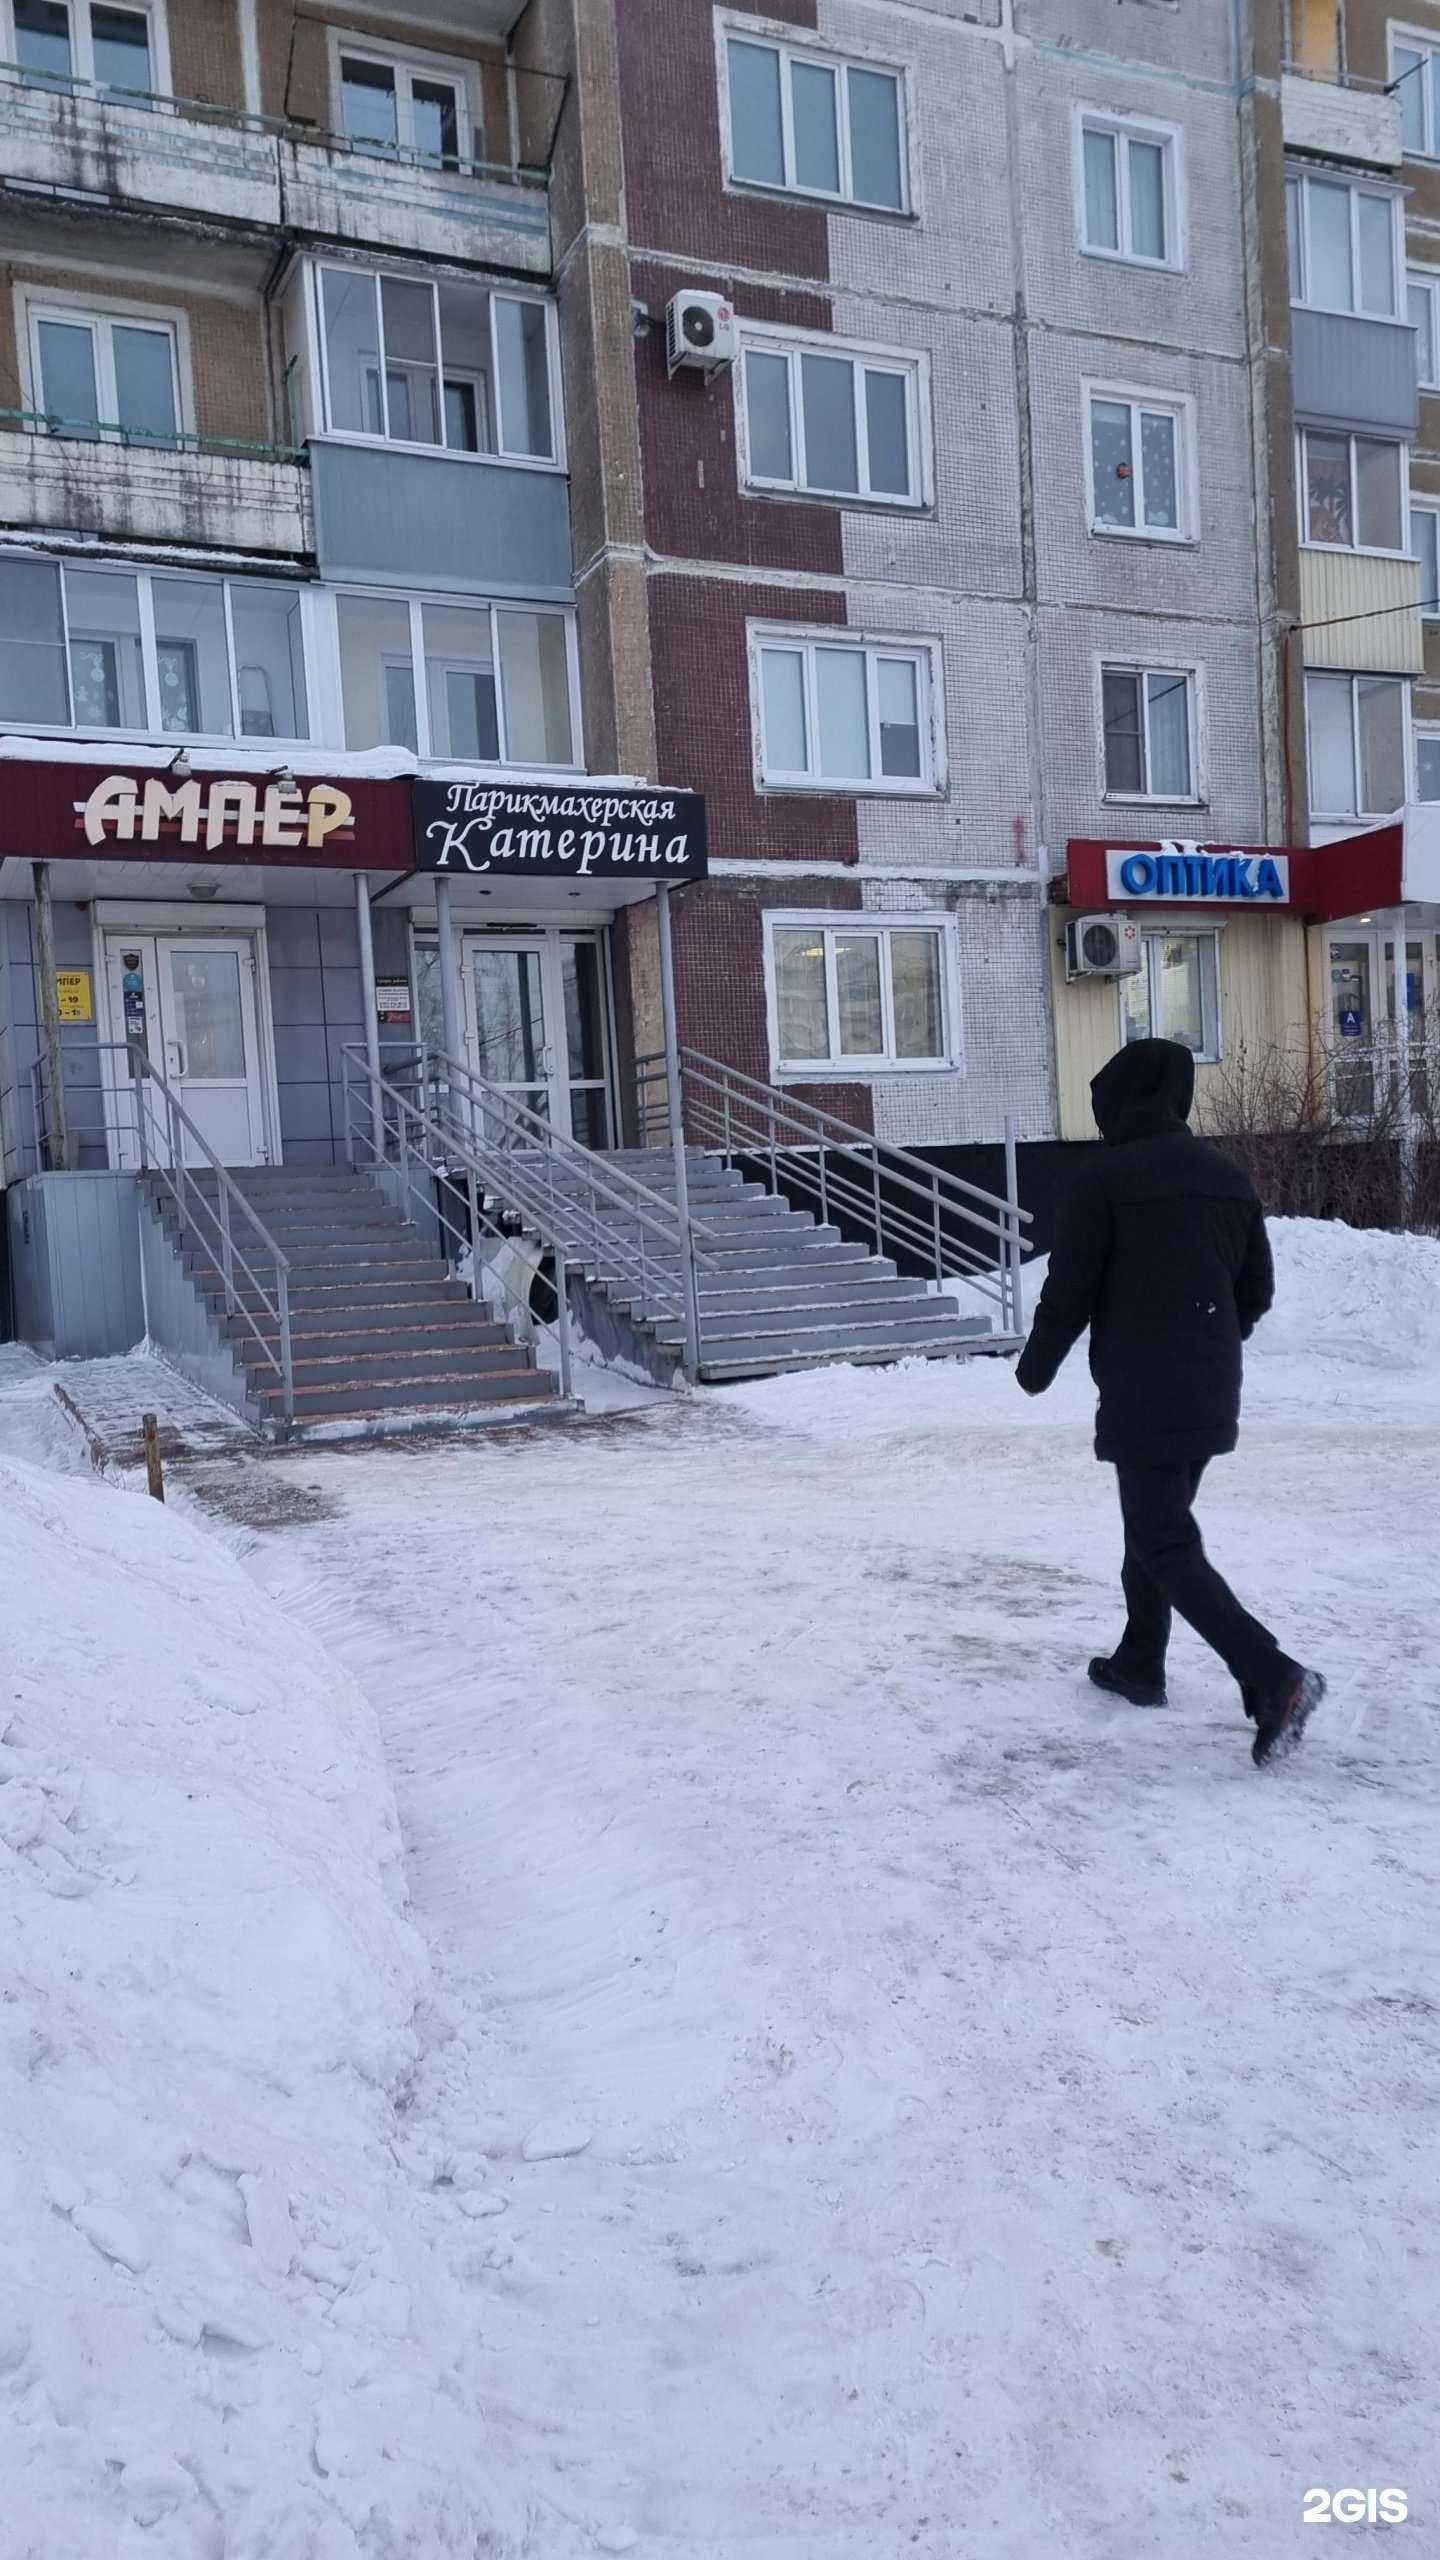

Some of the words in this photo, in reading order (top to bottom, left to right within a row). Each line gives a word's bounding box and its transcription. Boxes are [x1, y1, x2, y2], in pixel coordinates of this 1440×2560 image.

[84, 775, 352, 850] АМПЕР
[446, 783, 676, 827] Парикмахерская
[426, 817, 690, 875] Катерина
[1119, 853, 1285, 898] ОПТИКА
